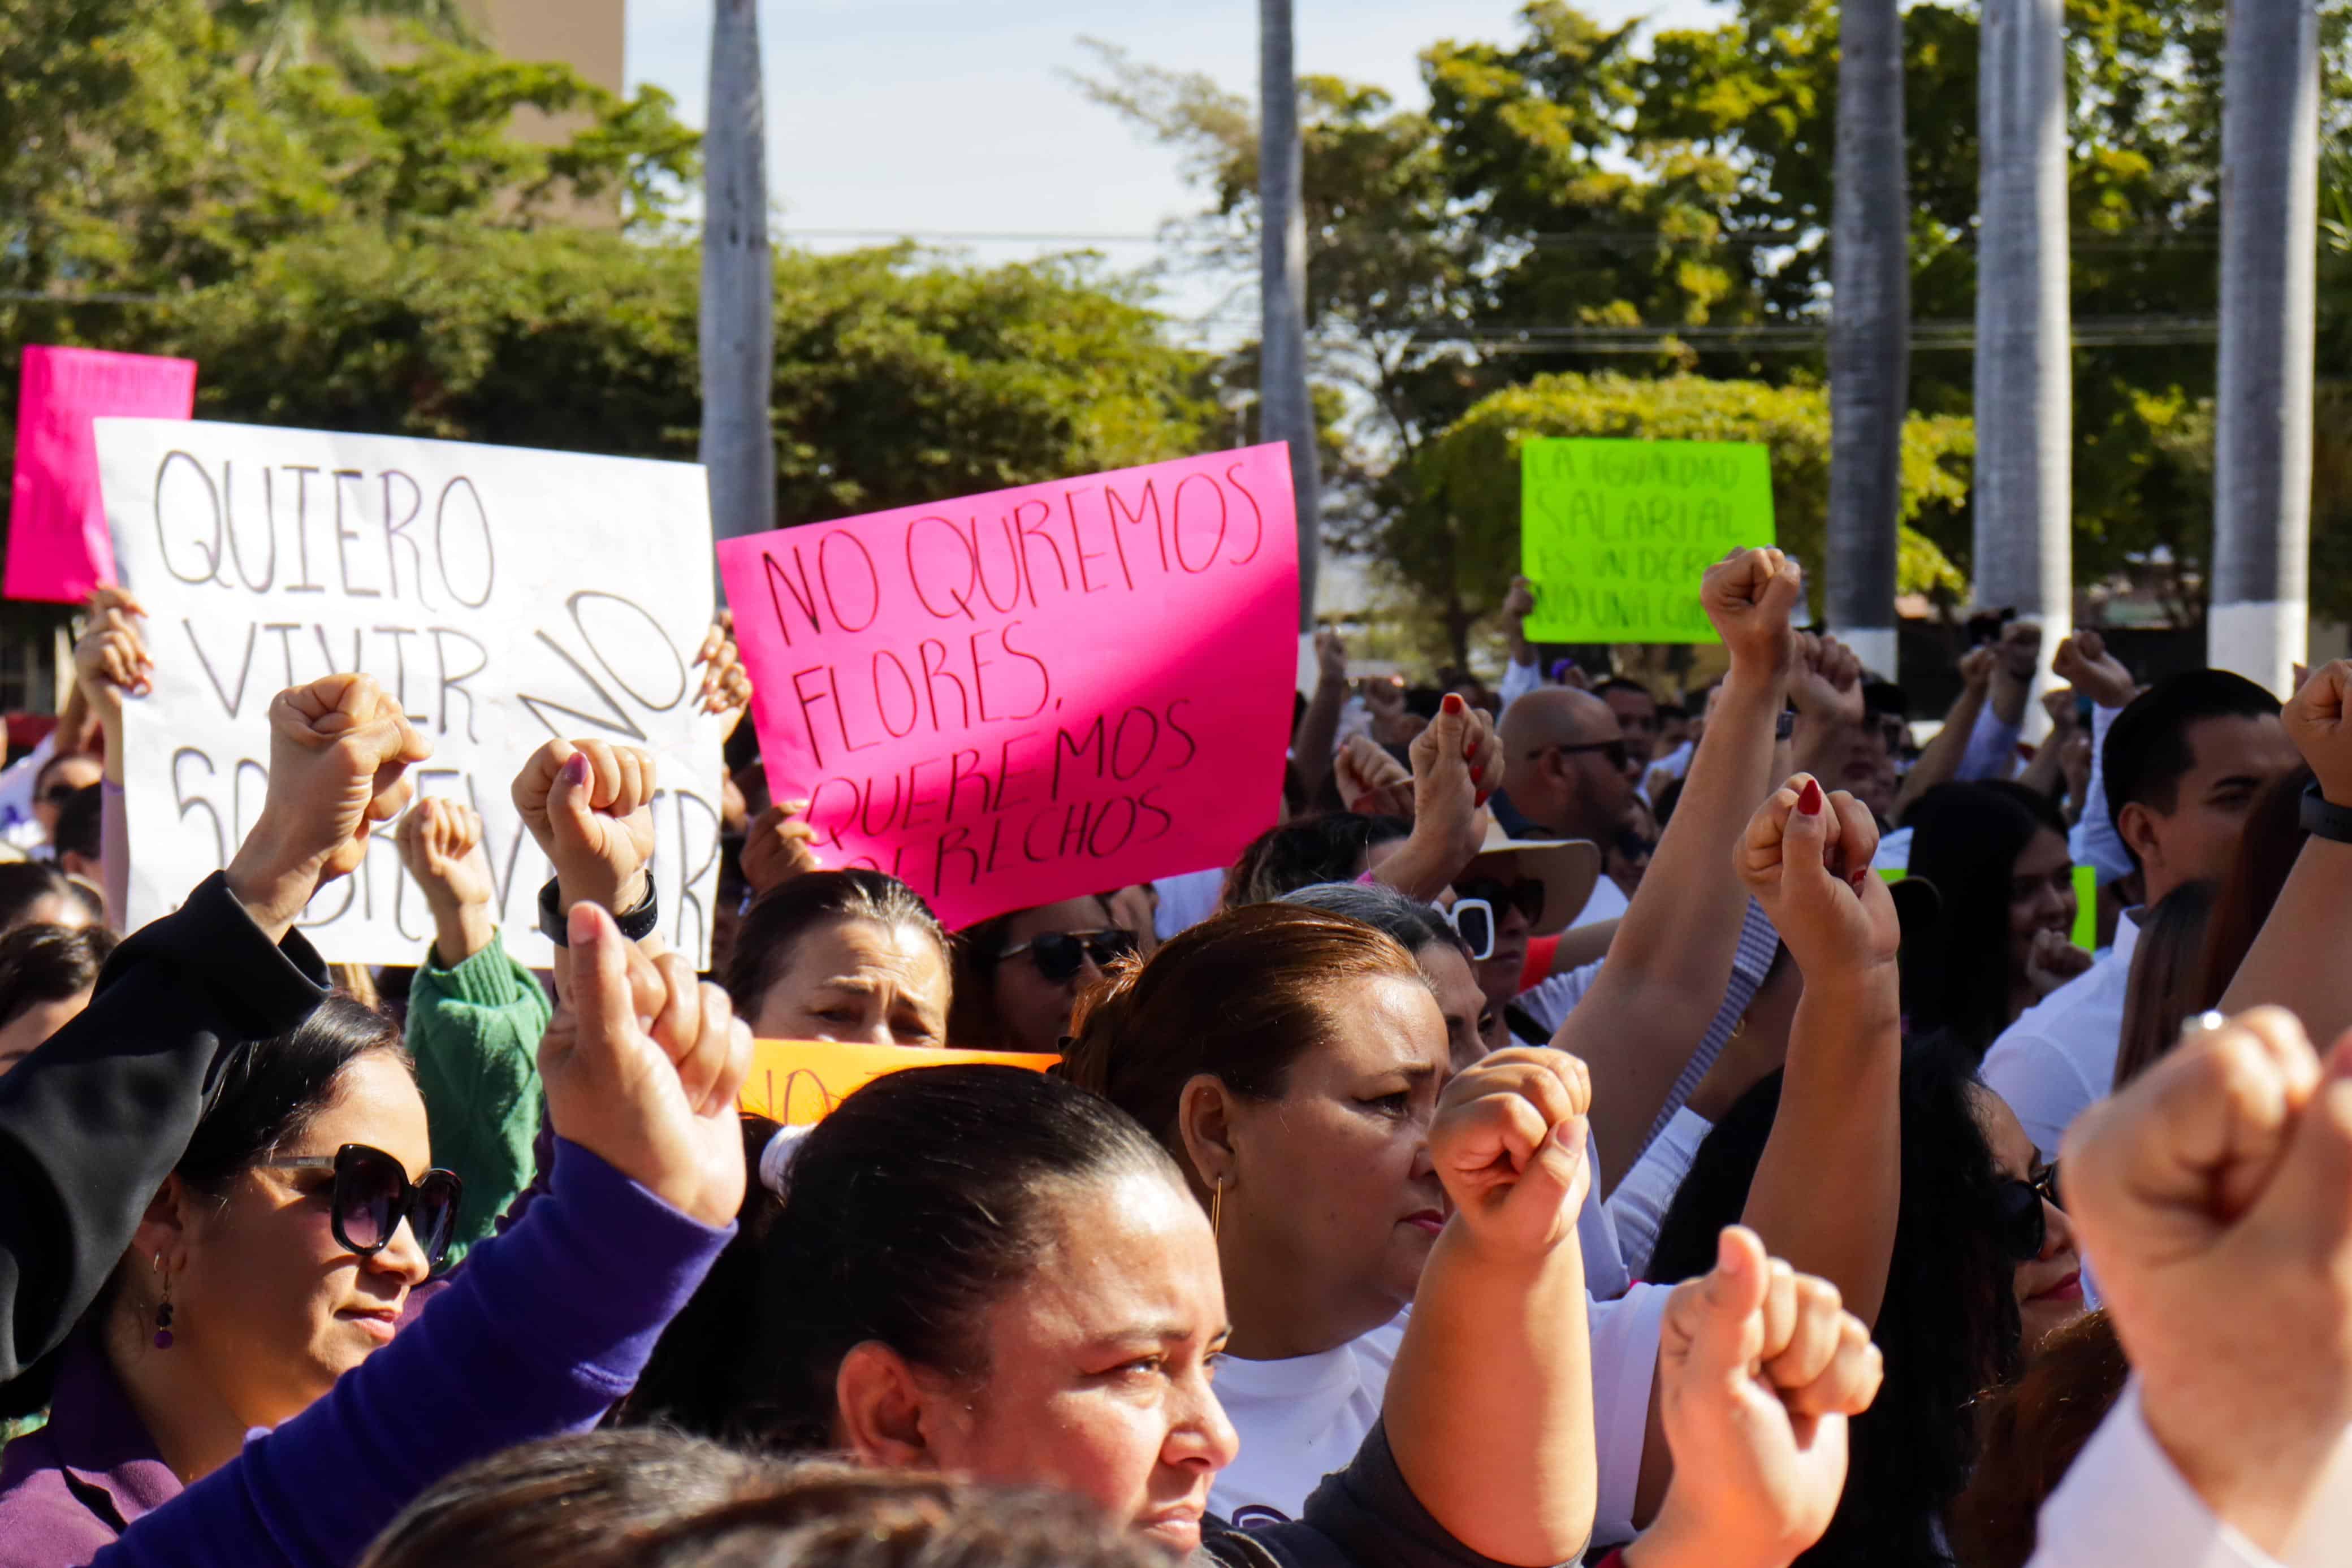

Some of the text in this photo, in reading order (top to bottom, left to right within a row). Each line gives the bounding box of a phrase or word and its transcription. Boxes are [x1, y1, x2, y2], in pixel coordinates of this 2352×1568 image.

[154, 450, 495, 612] QUIERO
[762, 462, 1263, 648] NO QUREMOS
[1535, 485, 1745, 542] SALARIAL
[183, 618, 487, 744] VIVIR
[516, 590, 686, 742] NO
[805, 699, 1197, 850] QUEREMOS
